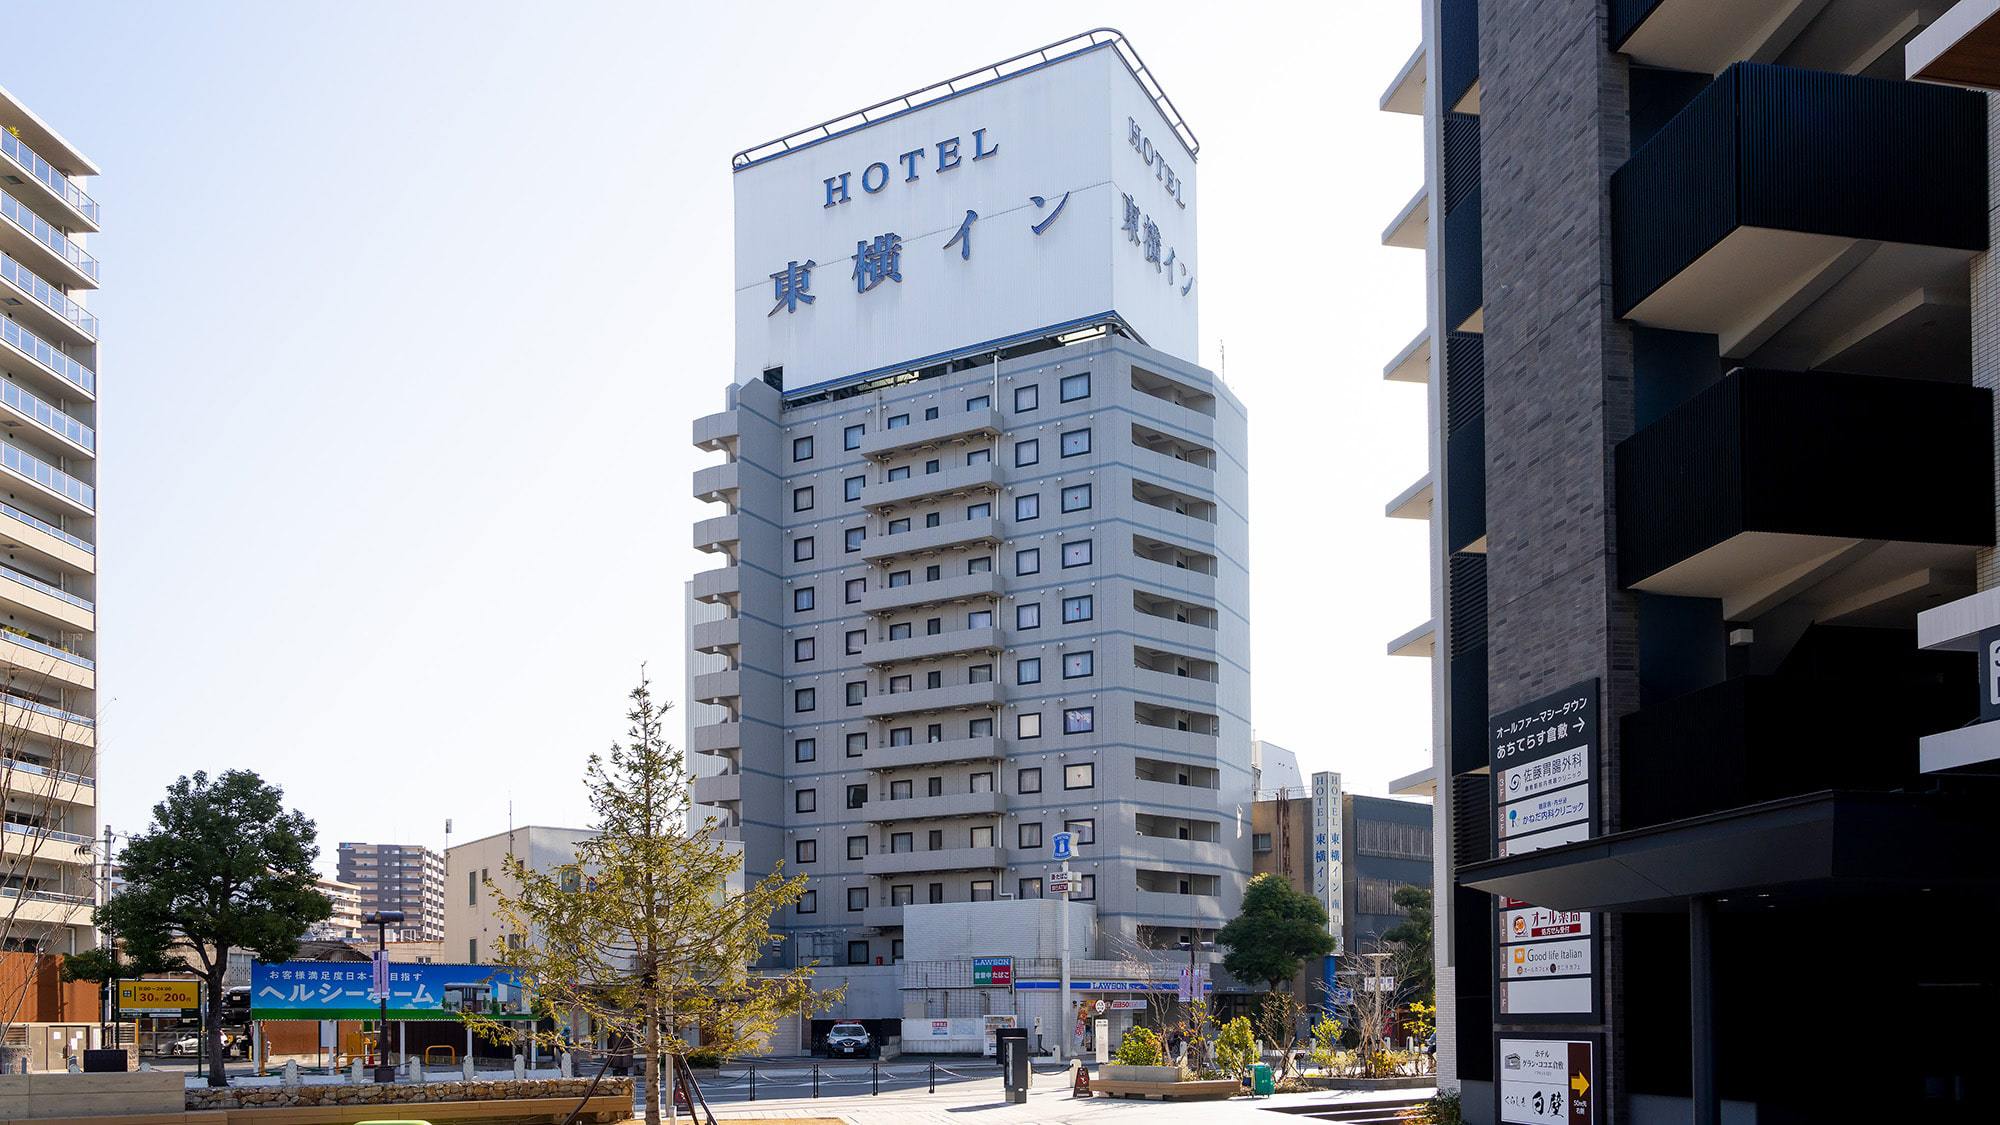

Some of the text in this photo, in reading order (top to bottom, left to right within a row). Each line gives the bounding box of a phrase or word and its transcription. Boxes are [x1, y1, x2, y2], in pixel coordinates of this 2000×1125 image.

[823, 127, 999, 209] HOTEL
[1128, 116, 1187, 210] HOTEL
[768, 191, 1071, 318] 東横イン
[1121, 193, 1194, 298] 東横イン
[1496, 698, 1587, 739] オールファーマシータウン
[1496, 722, 1569, 759] あちてらす倉敷
[1316, 776, 1324, 827] HOTEL
[1331, 775, 1339, 827] HOTEL
[270, 970, 422, 981] お客様満足度日本目指す
[1527, 948, 1582, 962] Good life Italian
[1092, 982, 1128, 990] LAWSON
[1535, 1050, 1549, 1058] ホテル
